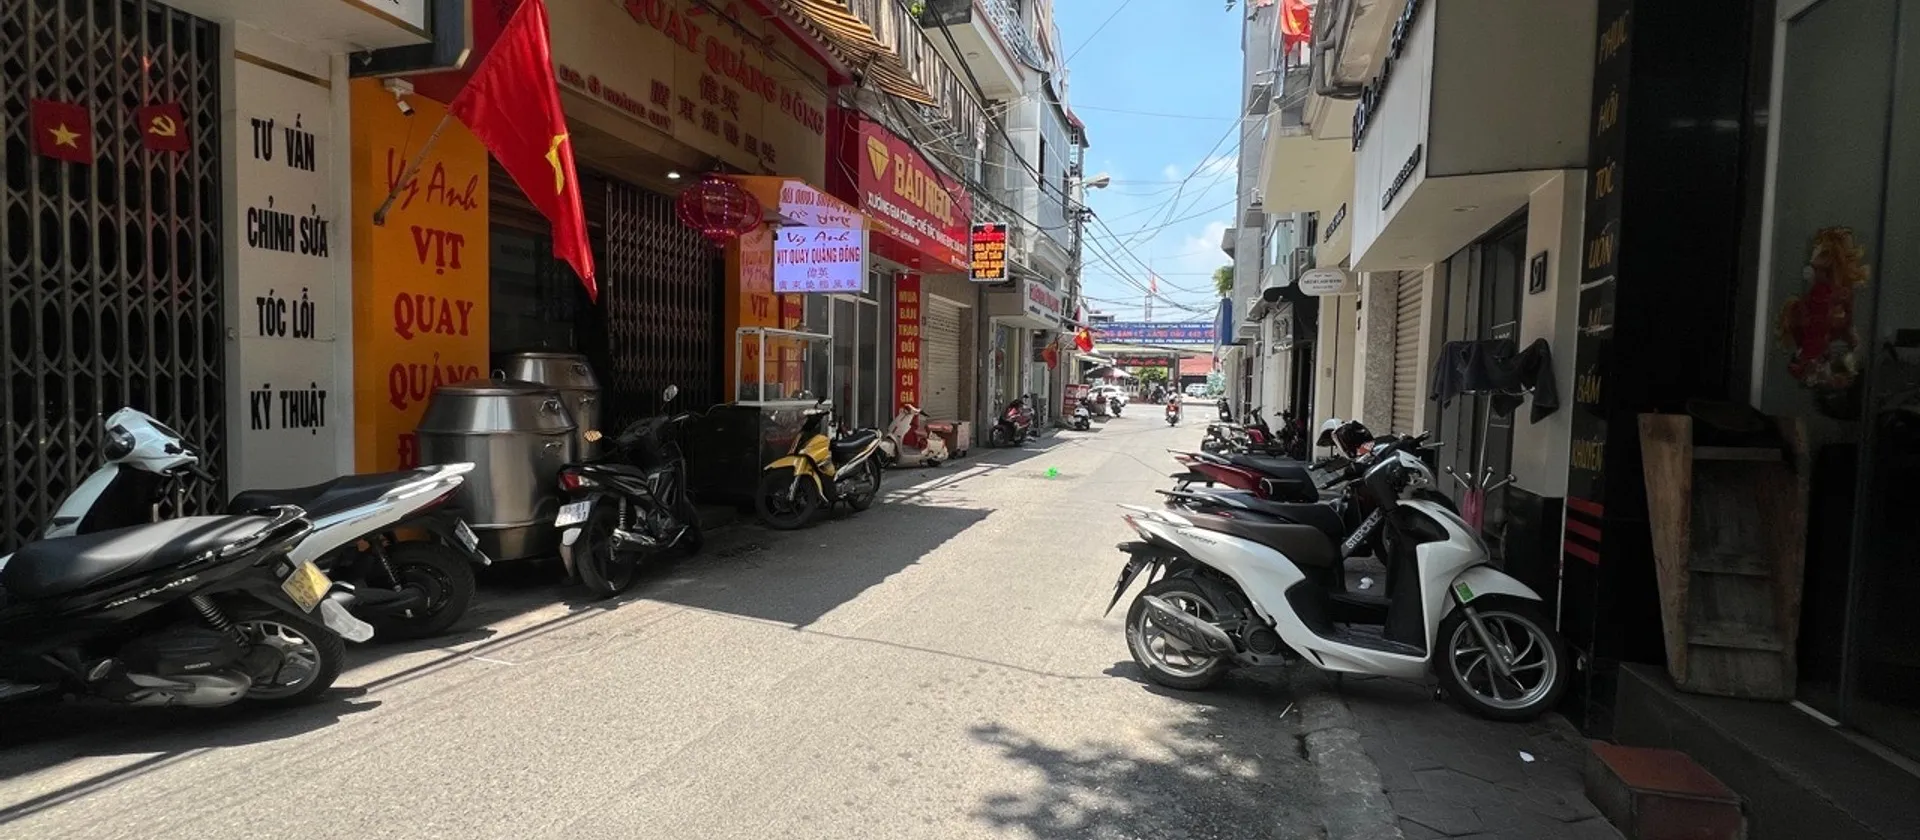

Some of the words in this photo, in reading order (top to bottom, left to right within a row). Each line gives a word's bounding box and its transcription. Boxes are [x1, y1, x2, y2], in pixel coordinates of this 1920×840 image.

[251, 117, 275, 161] TƯ
[285, 113, 316, 172] VẤN
[426, 160, 479, 212] Anh
[893, 152, 924, 209] BẢO
[247, 195, 295, 253] CHỈNH
[300, 203, 330, 258] SỬA
[411, 225, 465, 275] VỊT
[789, 247, 809, 266] QUAY
[811, 243, 837, 265] QUẢNG
[256, 288, 287, 338] TÓC
[293, 287, 315, 339] LỖI
[393, 292, 474, 340] QUAY
[250, 382, 272, 430] KỸ
[280, 382, 327, 435] THUẬT
